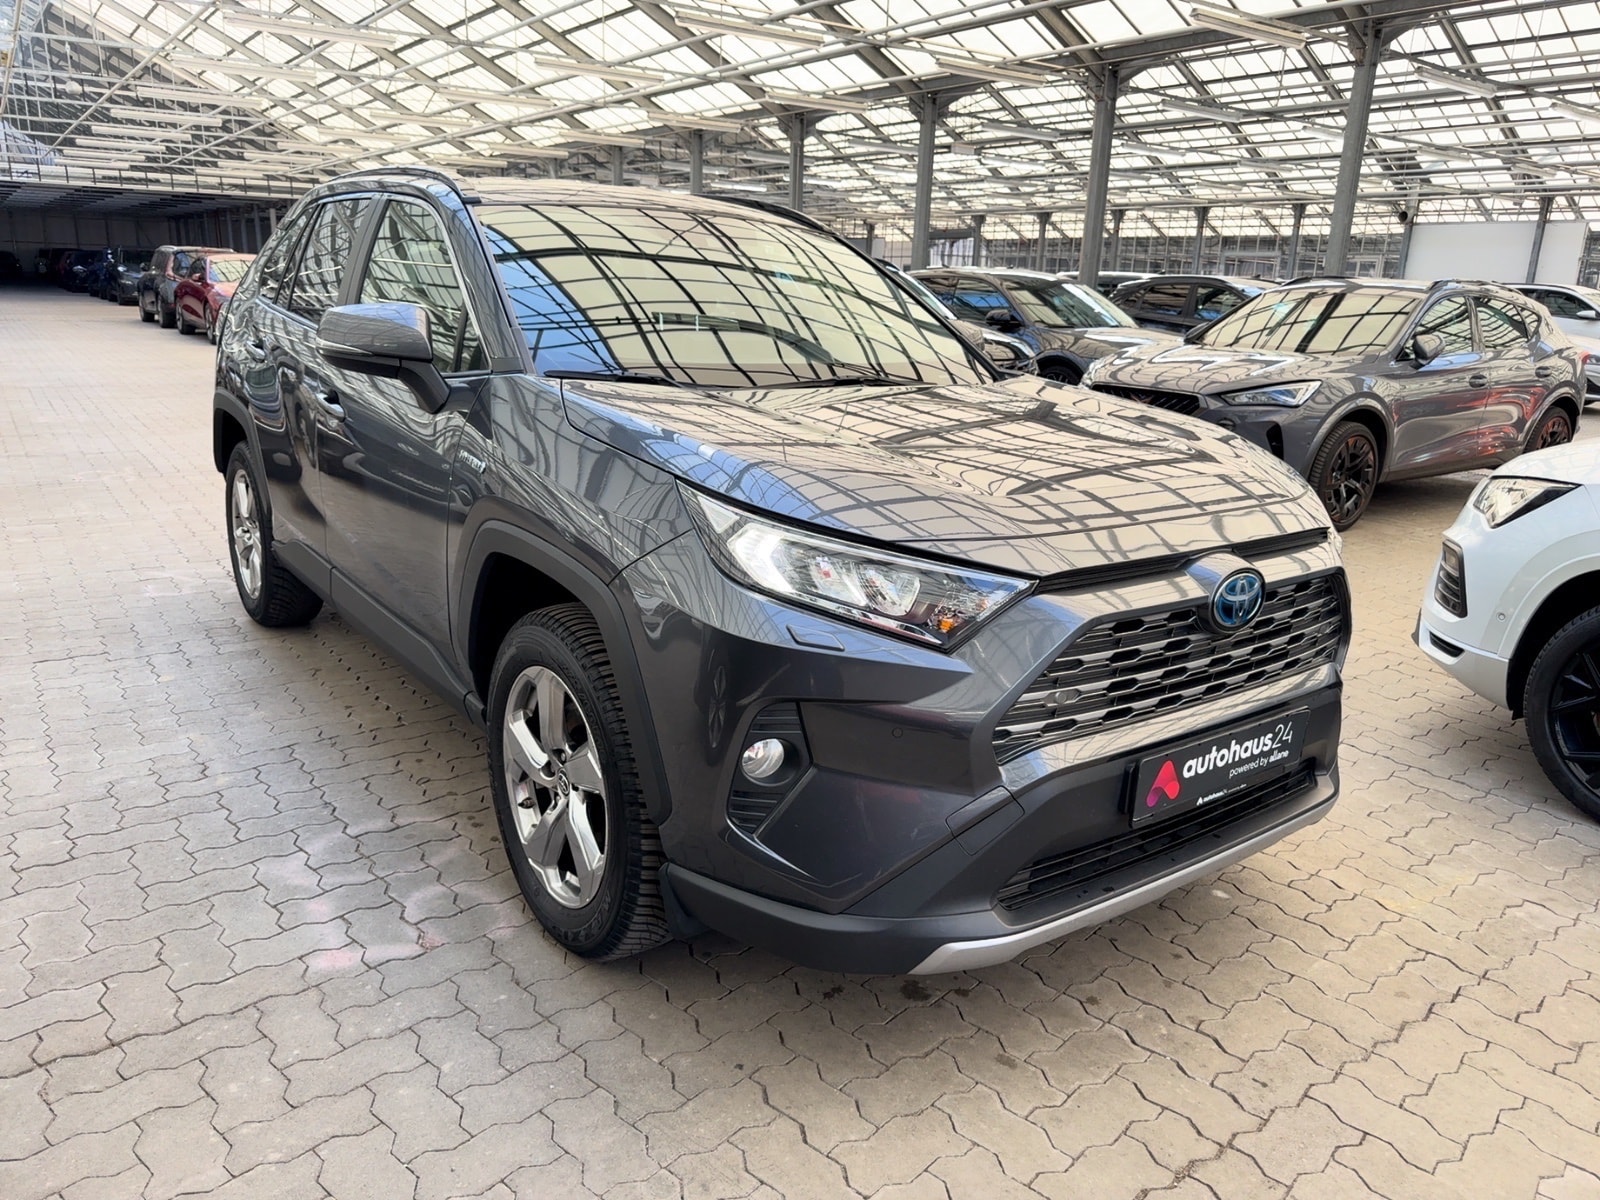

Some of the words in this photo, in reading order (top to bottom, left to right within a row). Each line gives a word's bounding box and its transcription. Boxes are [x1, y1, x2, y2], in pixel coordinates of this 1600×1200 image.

[1183, 721, 1293, 778] autohaus24
[1229, 757, 1259, 779] powered
[1260, 756, 1269, 767] by
[1269, 749, 1289, 763] allane
